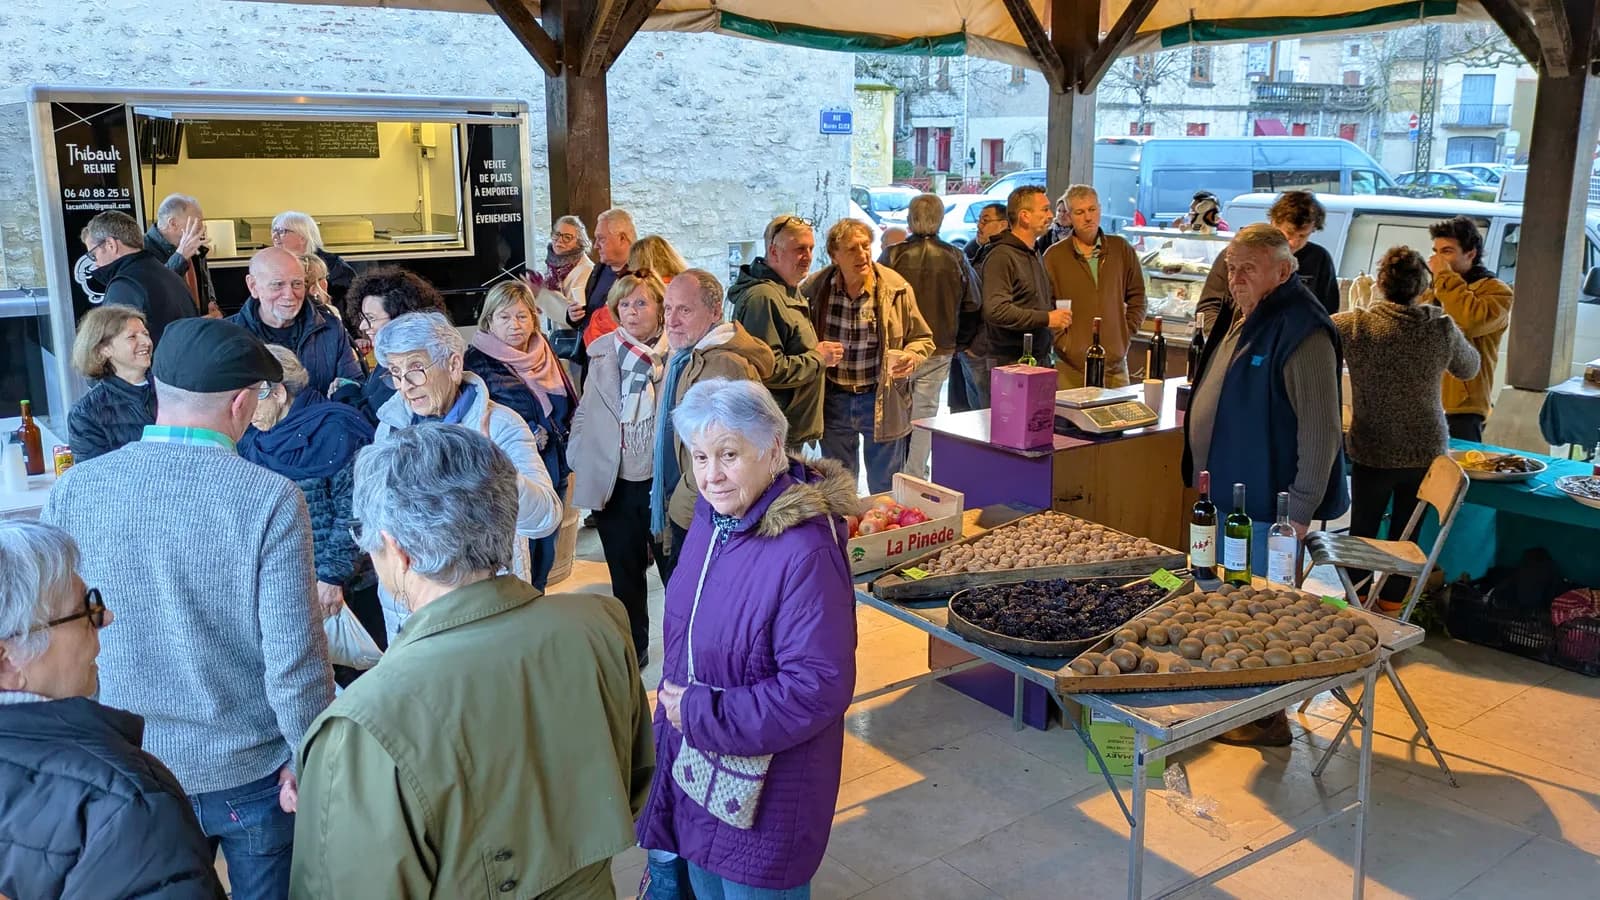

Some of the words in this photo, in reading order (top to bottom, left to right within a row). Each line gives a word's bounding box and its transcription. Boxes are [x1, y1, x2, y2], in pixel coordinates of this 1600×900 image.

[65, 143, 121, 166] Thibault
[483, 160, 506, 169] VENTE
[479, 173, 489, 183] DE
[490, 173, 512, 182] PLATS
[64, 188, 76, 198] 06
[79, 188, 90, 198] 40
[93, 188, 105, 198] 88
[107, 188, 119, 198] 25
[121, 188, 130, 197] 13
[474, 185, 480, 197] À
[481, 186, 519, 197] EMPORTER
[886, 539, 904, 557] La
[907, 526, 954, 550] Pinède
